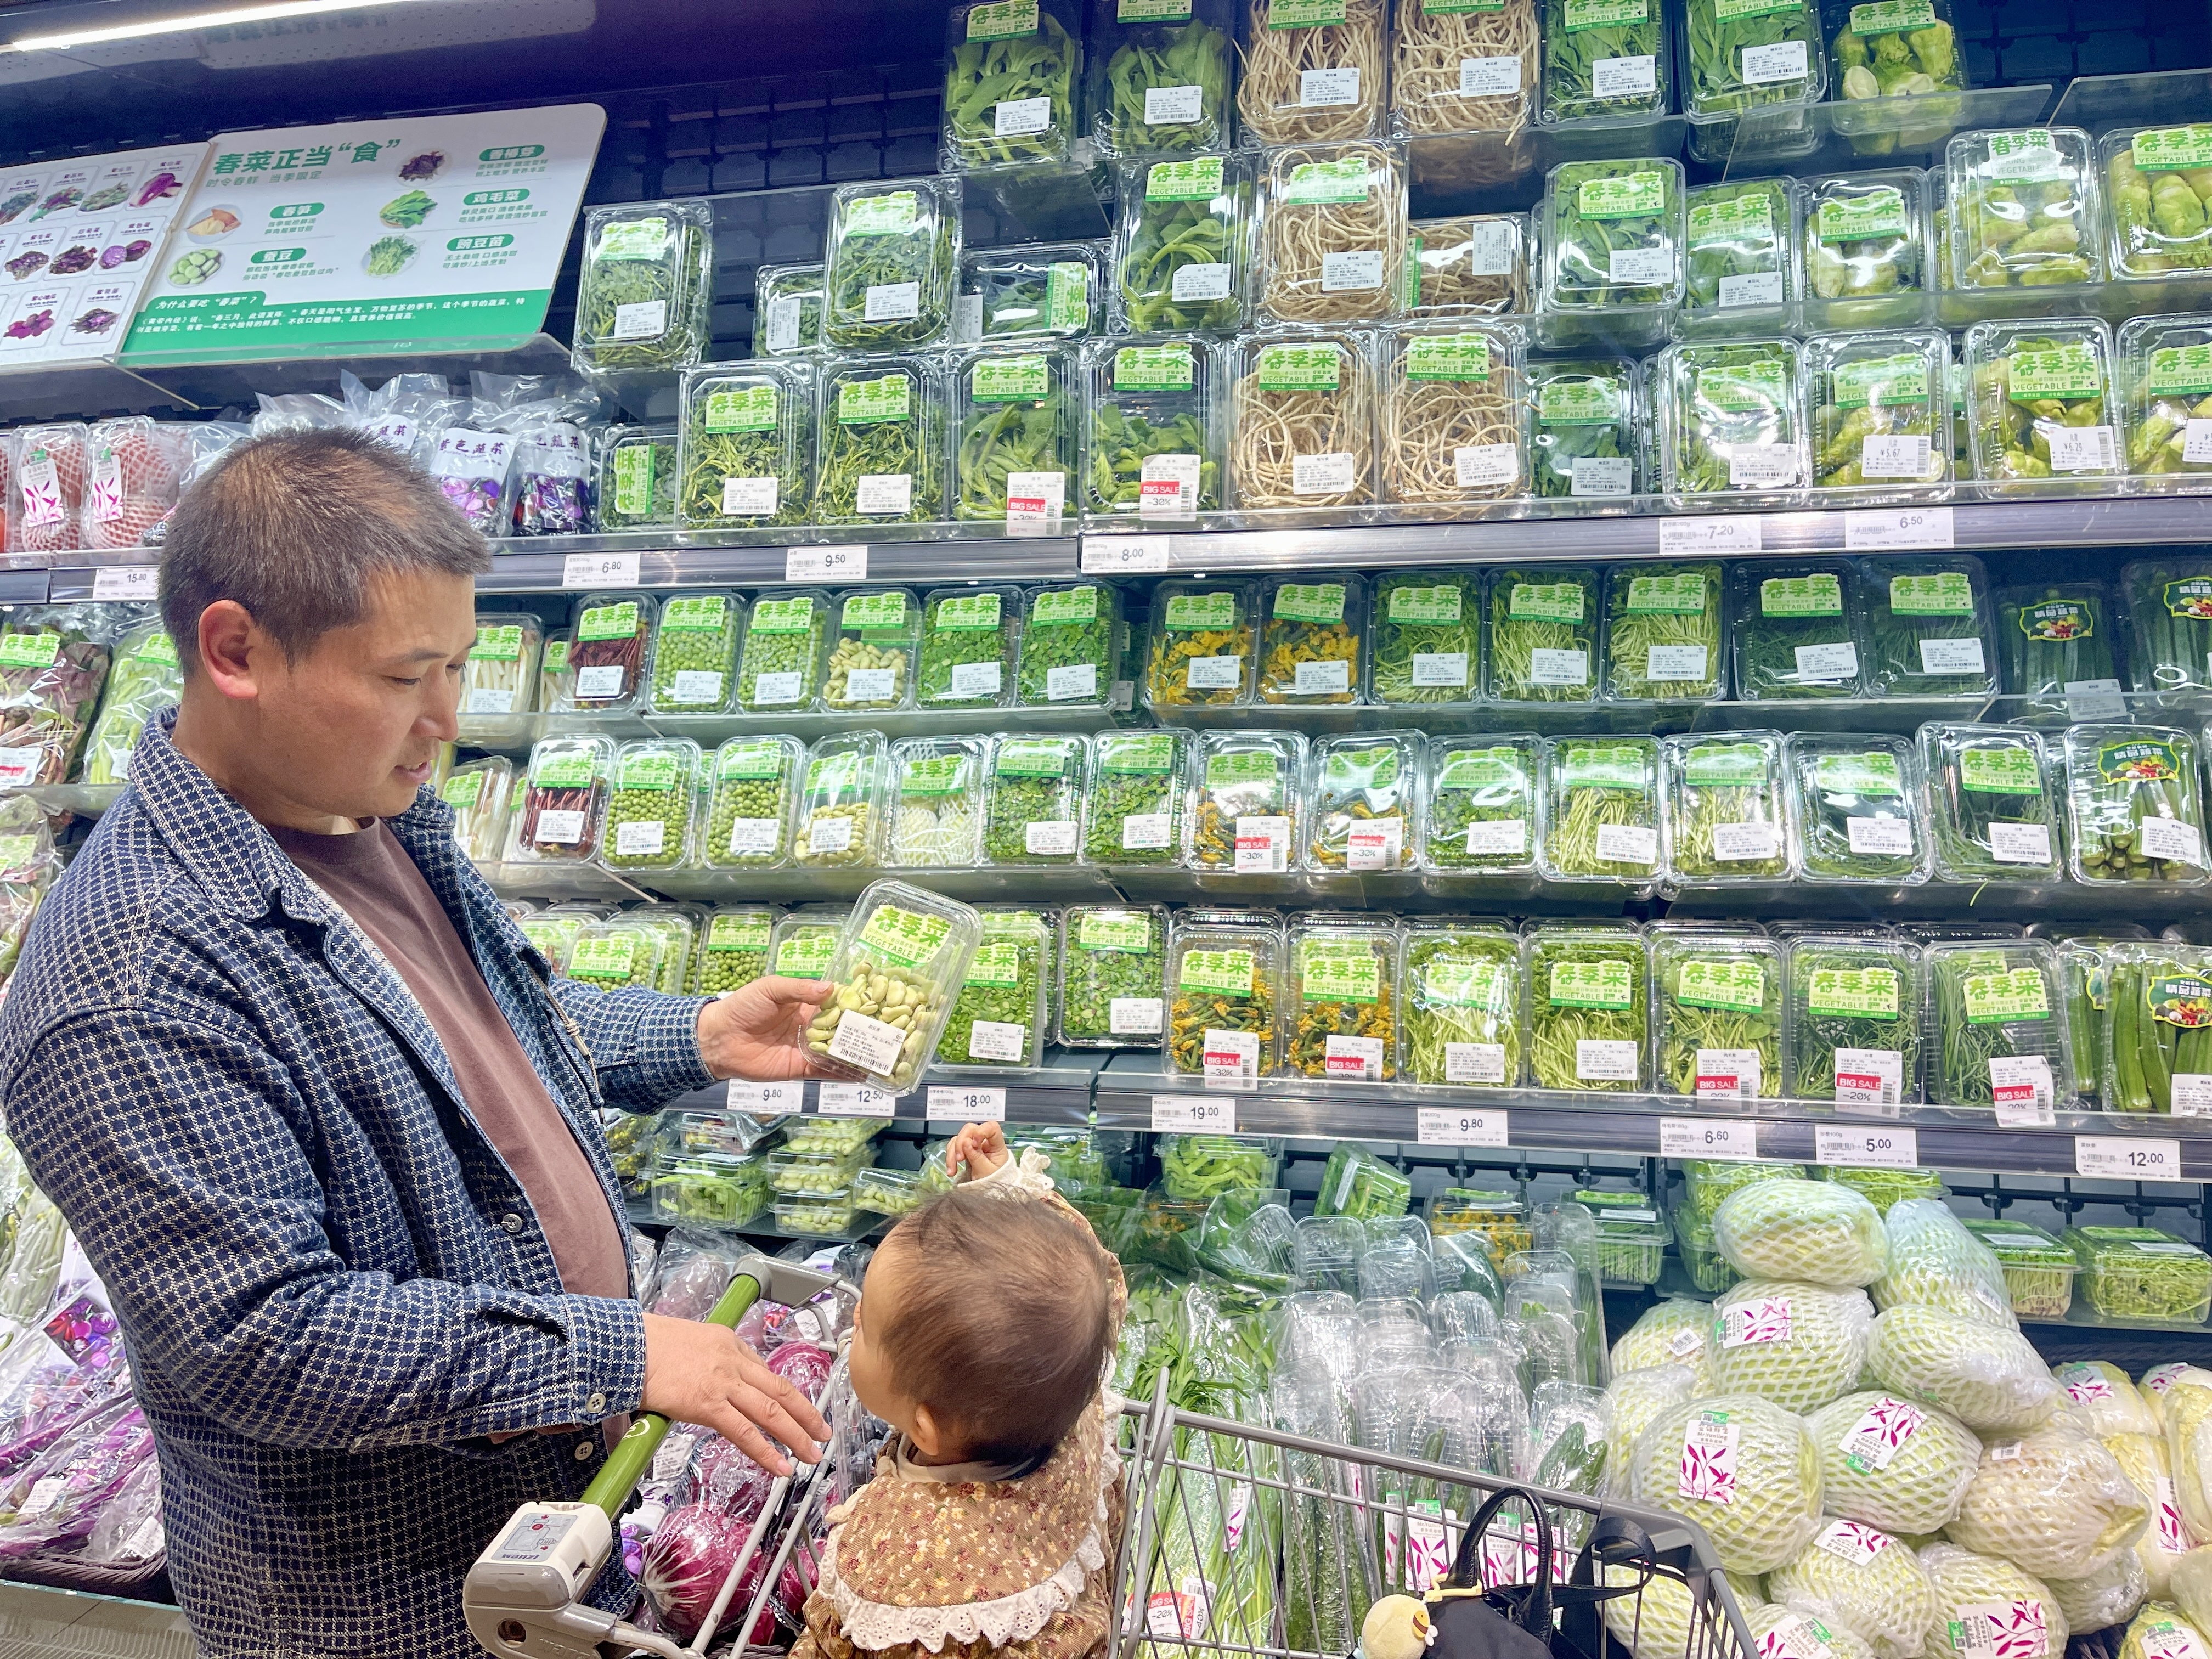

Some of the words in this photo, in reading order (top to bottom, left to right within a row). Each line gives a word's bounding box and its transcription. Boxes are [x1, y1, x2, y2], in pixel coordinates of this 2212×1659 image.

[1569, 13, 1616, 24] VEGETABLE
[1855, 20, 1905, 32] VEGETABLE
[2138, 155, 2192, 163] VEGETABLE
[206, 176, 258, 187] 时令春鲜
[268, 171, 322, 183] 当季限定
[472, 190, 521, 204] 鸡毛菜
[1292, 189, 1339, 198] VEGETABLE
[1823, 223, 1874, 235] VEGETABLE
[456, 236, 505, 249] 豌豆苗
[2013, 382, 2067, 391] VEGETABLE
[843, 408, 883, 416] VEGETABLE
[1900, 516, 1922, 528] 6.50
[1708, 526, 1733, 539] 7.20
[825, 554, 845, 567] 9.50
[1122, 549, 1143, 561] 8.00
[602, 561, 622, 573] 6.80
[127, 573, 146, 583] 15.80
[1183, 977, 1224, 987] VEGETABLE
[1554, 991, 1600, 1000] VEGETABLE
[1813, 1000, 1864, 1009] VEGETABLE
[1329, 1060, 1343, 1069] BIG
[1345, 1061, 1364, 1069] SALE
[1700, 1081, 1715, 1089] BIG
[1716, 1081, 1738, 1089] SALE
[1839, 1079, 1857, 1088] BIG
[1859, 1080, 1881, 1089] SALE
[763, 1089, 782, 1101] 9.80
[1997, 1091, 2012, 1099] BIG
[2014, 1090, 2035, 1099] SALE
[964, 1095, 990, 1107] 18.00
[1190, 1107, 1218, 1119] 19.00
[1461, 1118, 1482, 1132] 9.80
[1705, 1130, 1728, 1144] 6.60
[1866, 1138, 1891, 1150] 5.00
[2128, 1152, 2163, 1166] 12.00
[1151, 1599, 1162, 1608] BIG
